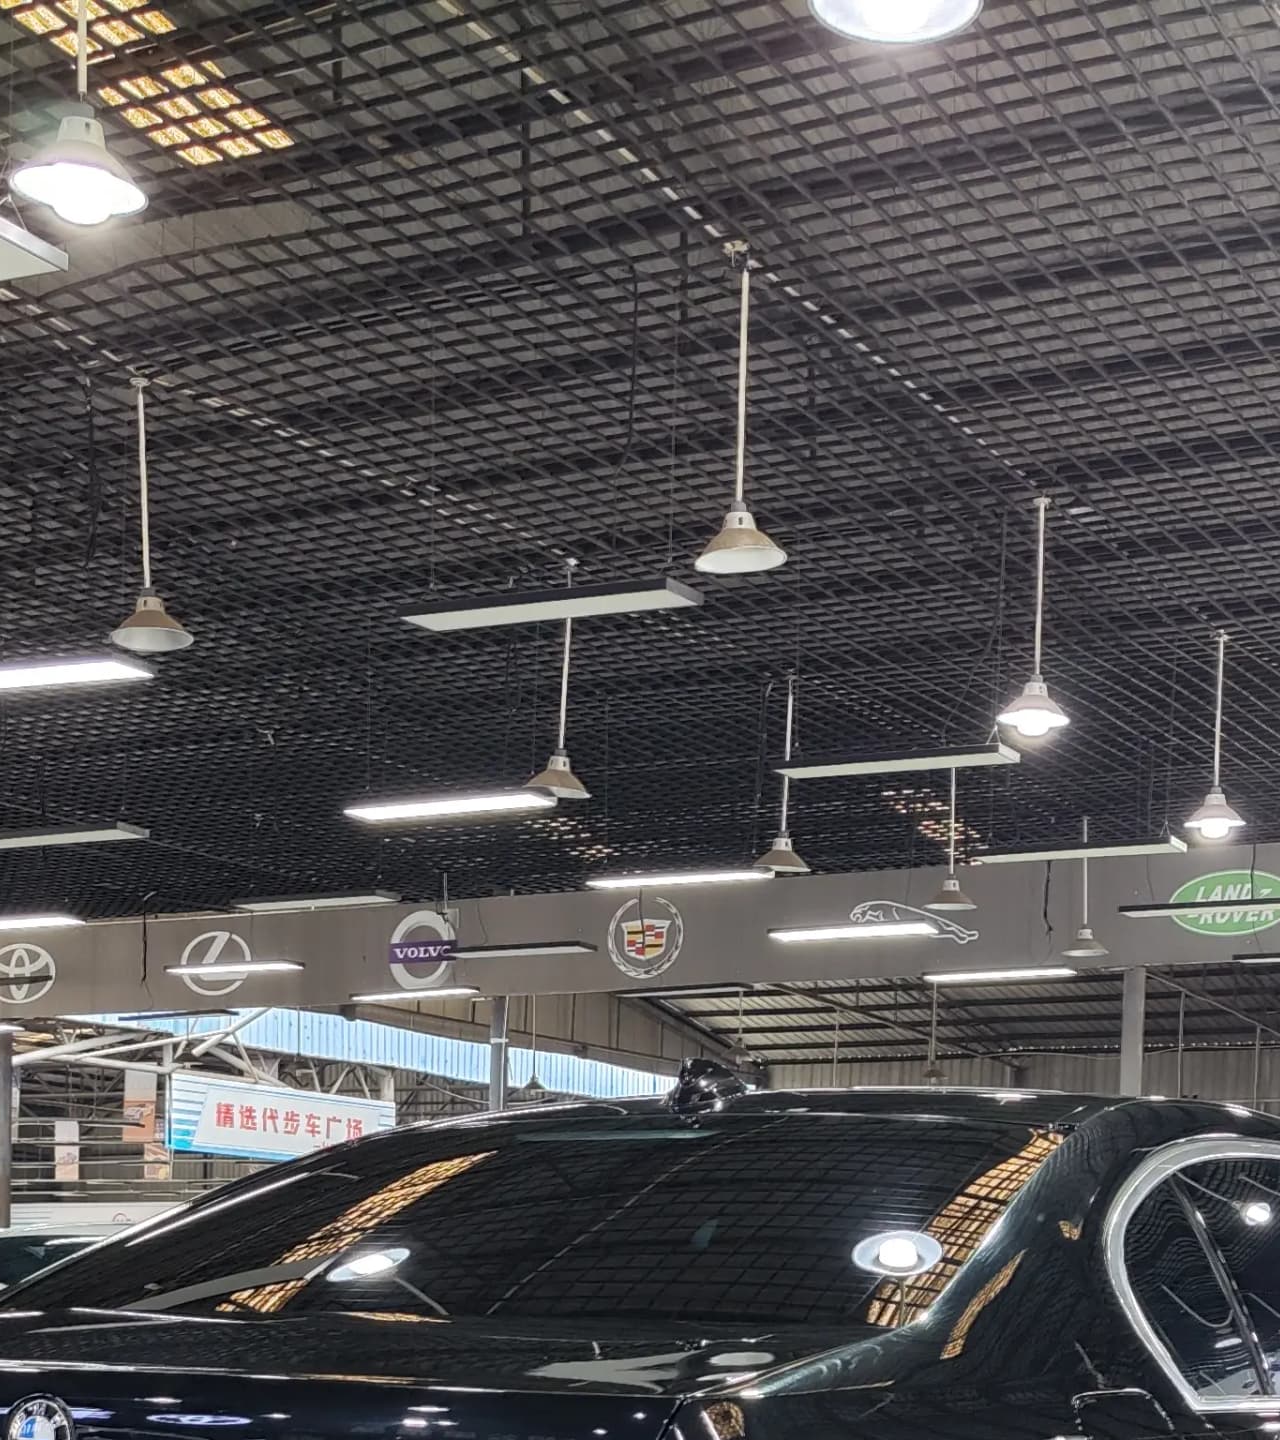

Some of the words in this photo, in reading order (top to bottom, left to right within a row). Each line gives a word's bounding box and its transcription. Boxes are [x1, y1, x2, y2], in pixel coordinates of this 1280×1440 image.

[1195, 883, 1253, 902] LAND
[216, 1101, 364, 1141] 精选代步车广场
